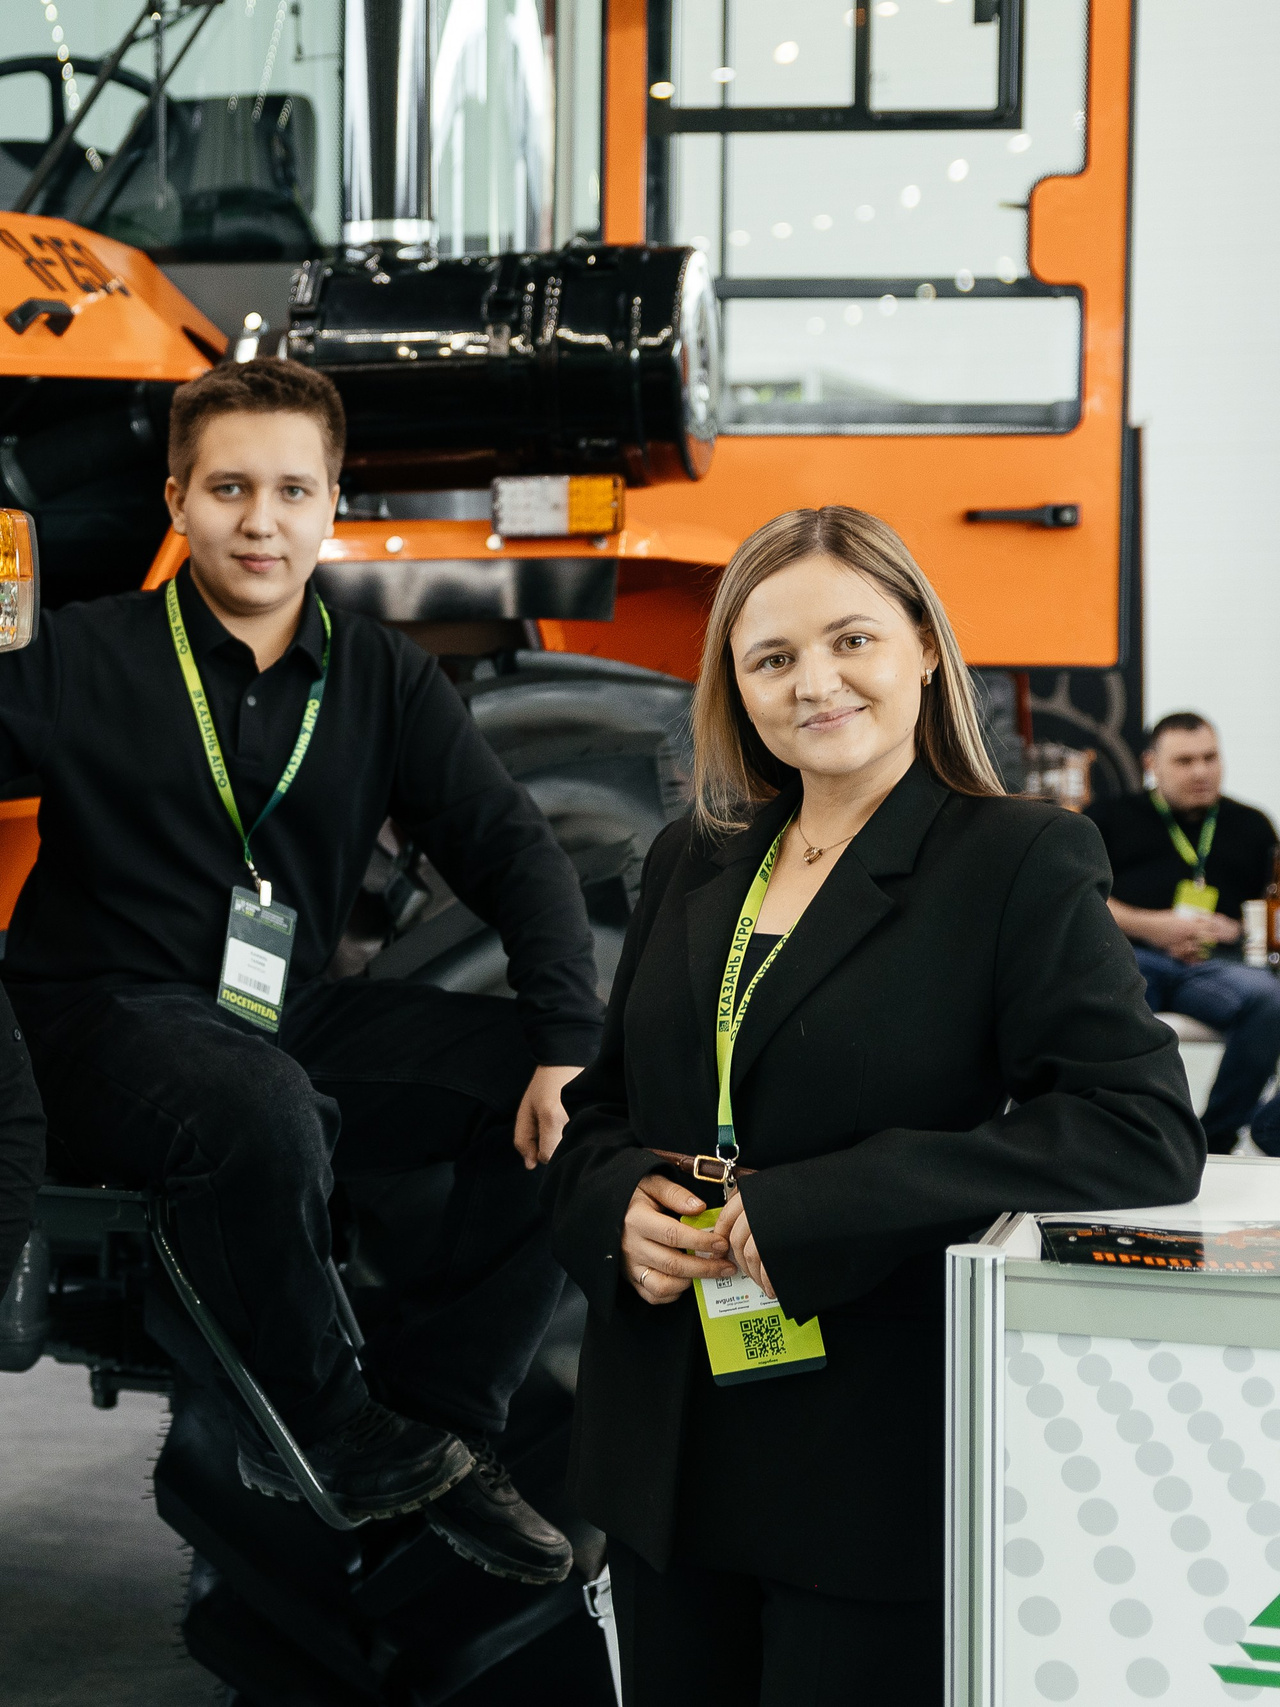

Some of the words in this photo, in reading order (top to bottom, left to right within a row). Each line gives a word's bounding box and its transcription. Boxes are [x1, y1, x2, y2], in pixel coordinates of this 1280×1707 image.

[175, 626, 188, 654] АГРО
[197, 700, 215, 751] КАЗАНЬ
[211, 755, 227, 788] АГРО
[282, 733, 311, 786] КАЗАНЬ
[302, 699, 320, 734] АГРО
[720, 955, 741, 1017] КАЗАНЬ
[733, 916, 754, 952] АГРО
[222, 989, 278, 1021] ПОСЕТИТЕЛЬ
[716, 1297, 735, 1305] avgust
